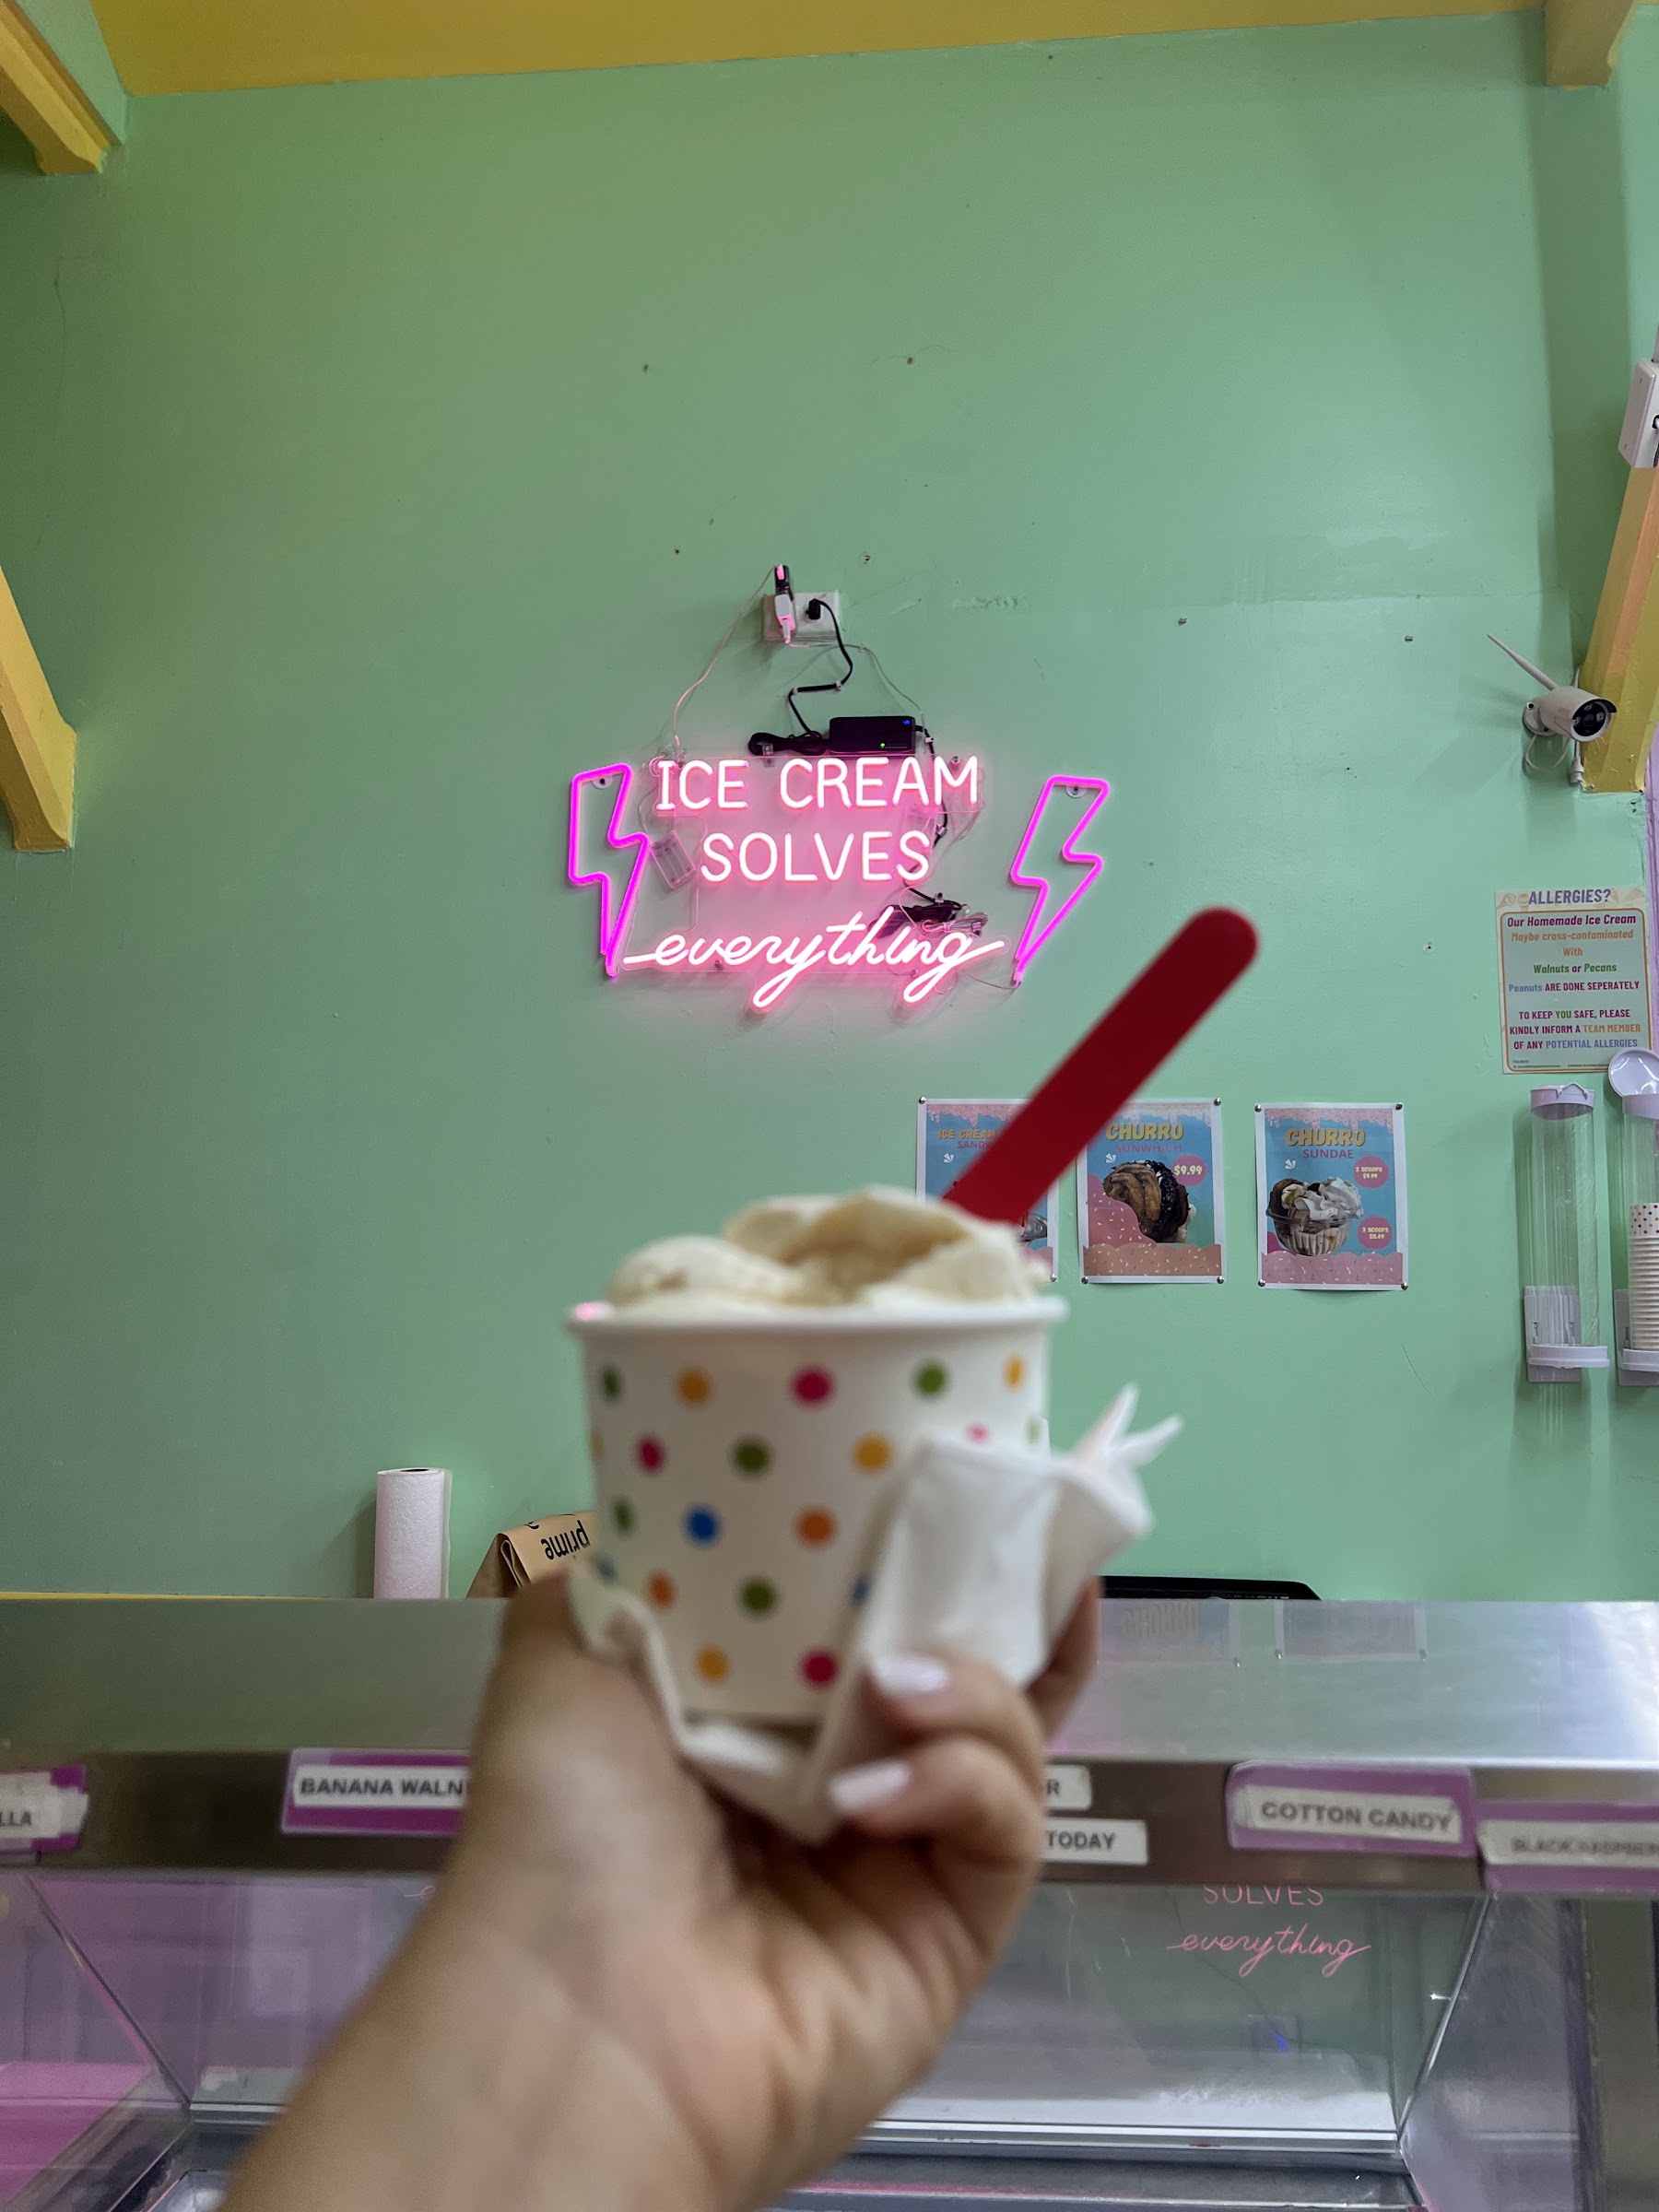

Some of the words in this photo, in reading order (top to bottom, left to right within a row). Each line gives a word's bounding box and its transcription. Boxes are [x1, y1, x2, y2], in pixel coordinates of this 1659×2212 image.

[655, 757, 749, 811] ICE
[779, 756, 979, 809] CREAM
[700, 830, 931, 883] SOLVES
[1529, 888, 1611, 905] ALLERGIES?
[1507, 917, 1524, 927] Our
[1527, 915, 1583, 927] Homemade
[1585, 914, 1601, 925] Ice
[1604, 914, 1637, 924] Cream
[1512, 932, 1540, 944] Maybe
[1542, 929, 1634, 941] cross-contaminated
[623, 906, 1006, 1009] everything
[1563, 947, 1583, 957] With
[1534, 964, 1570, 974] Walnuts
[1571, 965, 1582, 973] or
[1583, 963, 1617, 972] Pecans
[1509, 983, 1543, 993] Peanuts
[1545, 982, 1561, 992] ARE
[1563, 982, 1585, 991] DONE
[1587, 981, 1640, 991] SEPERATELY
[1519, 1011, 1530, 1019] TO
[1532, 1010, 1553, 1019] KEEP
[1555, 1010, 1571, 1018] YOU
[1573, 1009, 1597, 1019] SAFE,
[1599, 1009, 1630, 1018] PLEASE
[1510, 1026, 1539, 1035] KINDLY
[1542, 1025, 1572, 1034] INFORM
[1575, 1025, 1581, 1033] A
[1583, 1024, 1606, 1032] TEAM
[1607, 1023, 1641, 1032] MEMBER
[1513, 1041, 1524, 1050] OF
[1526, 1041, 1544, 1049] ANY
[1546, 1039, 1592, 1049] POTENTIAL
[1594, 1039, 1638, 1048] ALLERGIES
[938, 1129, 956, 1140] ICE
[959, 1129, 996, 1140] CREAM
[1106, 1123, 1184, 1141] CHURRO
[1285, 1127, 1366, 1147] CHURRO
[1302, 1148, 1354, 1159] SUNDAE
[1173, 1164, 1203, 1176] $9.99
[540, 1520, 591, 1560] prime
[300, 1777, 394, 1795] BANANA
[401, 1778, 464, 1795] WALN
[1261, 1800, 1362, 1825] COTTON
[1368, 1807, 1453, 1832] CANDY
[1047, 1830, 1115, 1851] TODAY
[1203, 1885, 1324, 1906] SOLVES
[1167, 1923, 1371, 1977] everything
